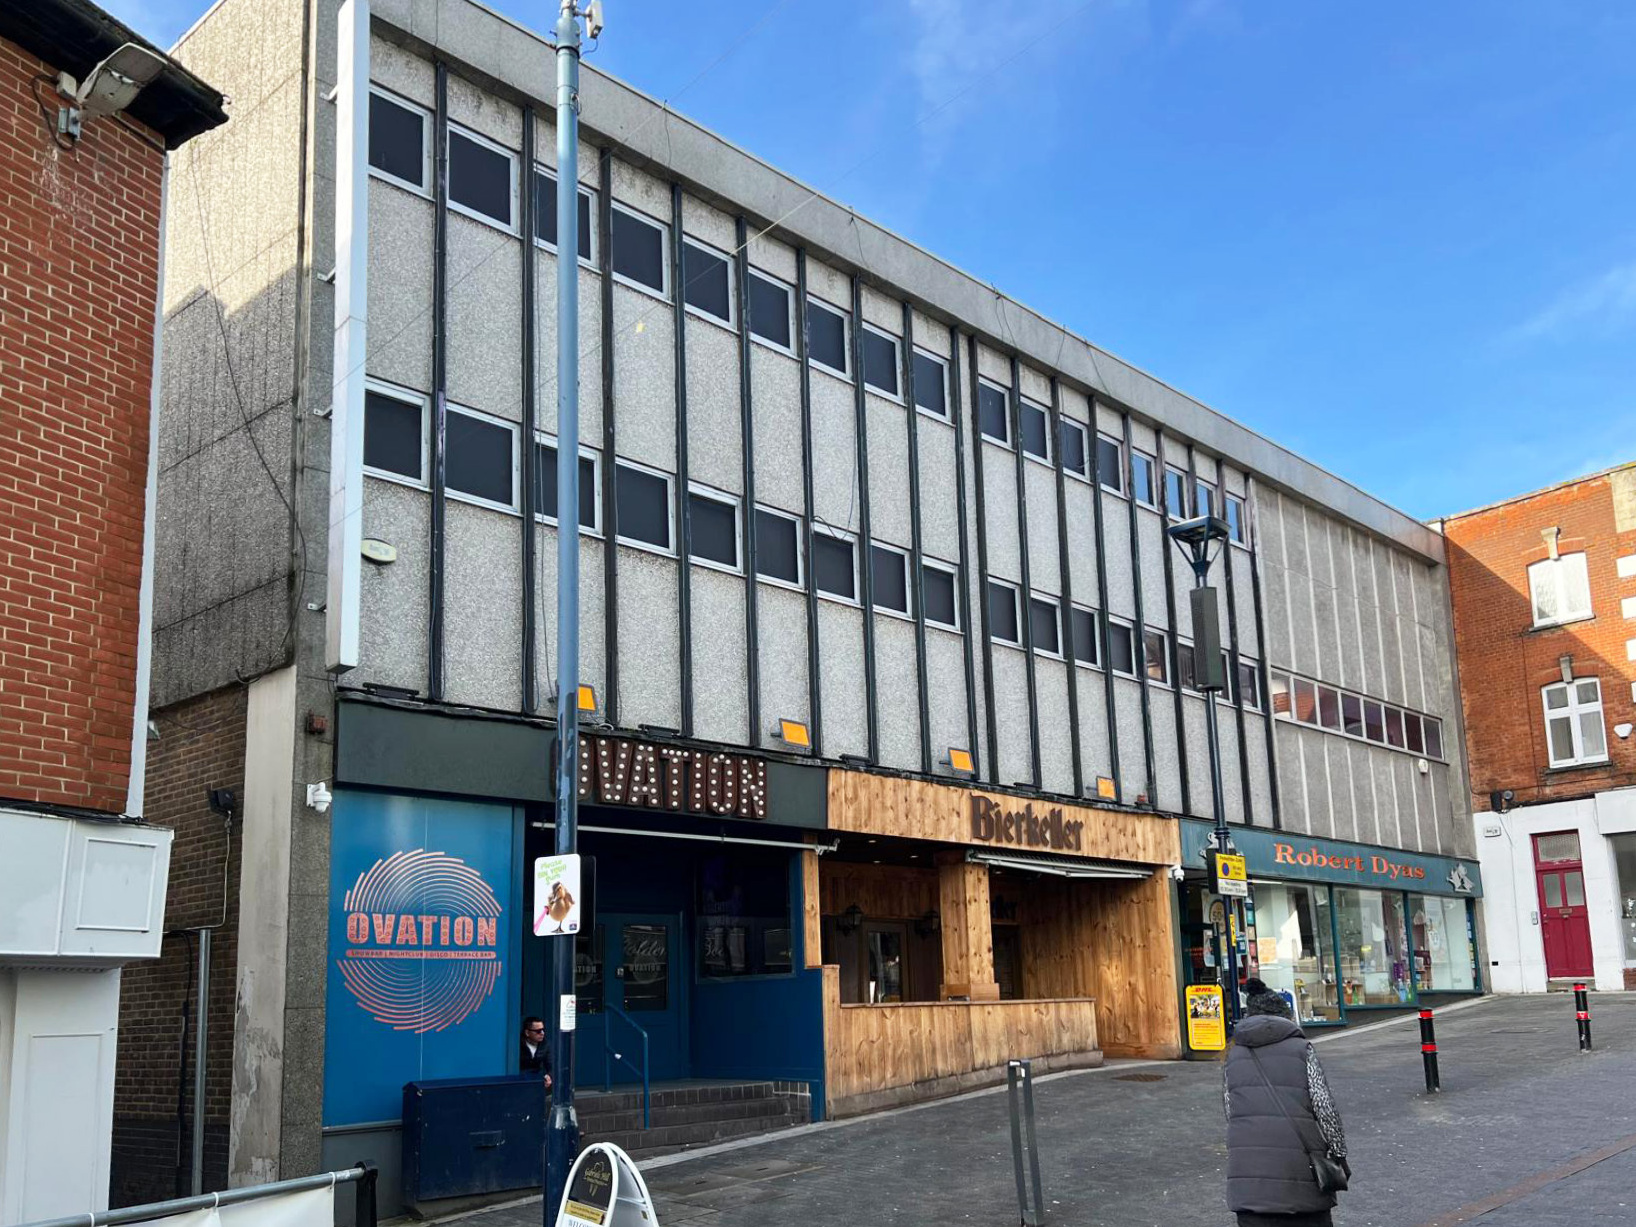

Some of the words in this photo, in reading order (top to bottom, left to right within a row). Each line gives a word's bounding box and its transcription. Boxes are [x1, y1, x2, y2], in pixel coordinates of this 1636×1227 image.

[970, 792, 1084, 851] Bierkeller
[1274, 843, 1365, 872] Robert
[1371, 856, 1425, 880] Dyas
[347, 912, 496, 946] OVATION
